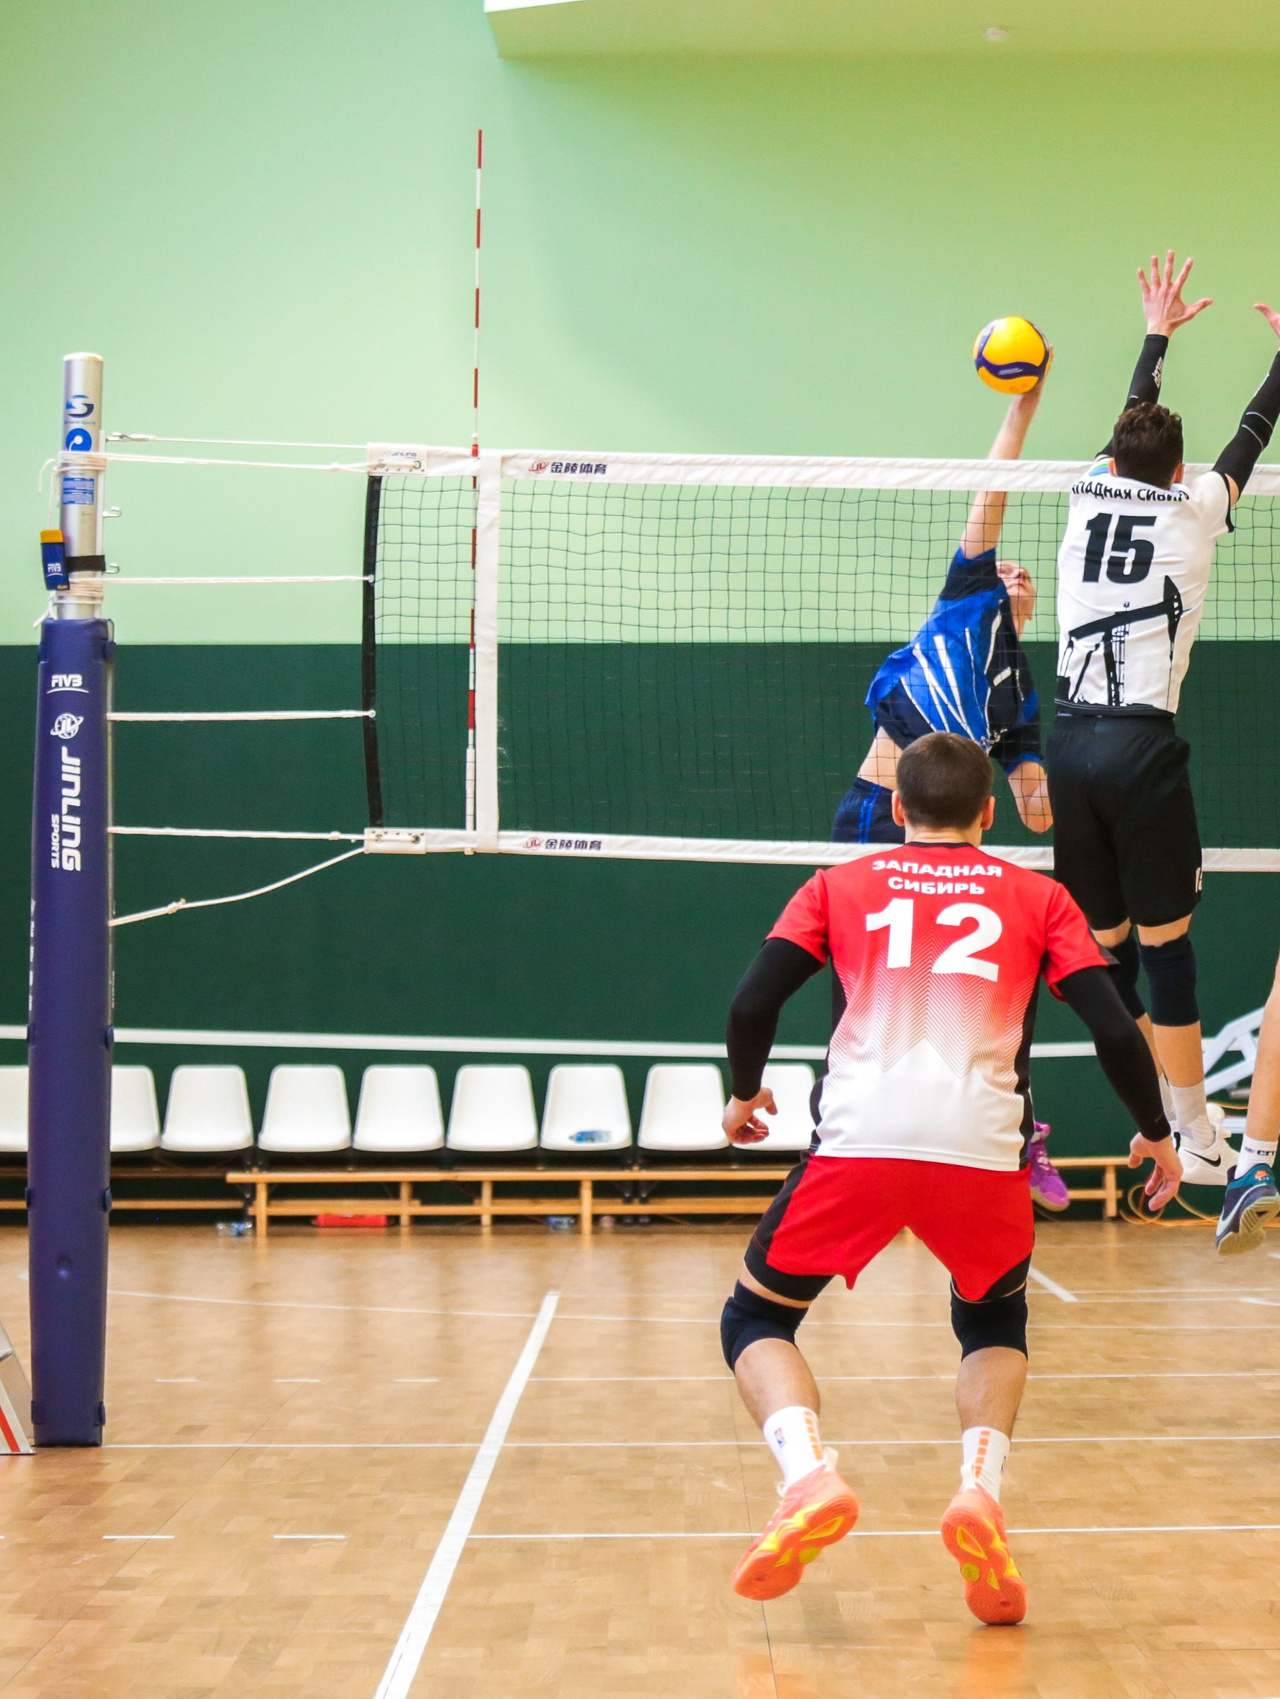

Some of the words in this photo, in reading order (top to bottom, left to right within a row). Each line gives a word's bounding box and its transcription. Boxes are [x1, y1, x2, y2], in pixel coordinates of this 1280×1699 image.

[551, 461, 608, 475] 金陵体育
[1082, 512, 1158, 584] 15
[47, 563, 62, 573] FIVB
[51, 674, 83, 688] FIVB
[61, 745, 82, 872] JINLING
[51, 813, 60, 869] SPORTS
[545, 838, 602, 850] 金陵体育
[872, 859, 1002, 878] ЗАПАДНАЯ
[887, 876, 985, 895] СИБИРЬ
[865, 897, 1003, 982] 12
